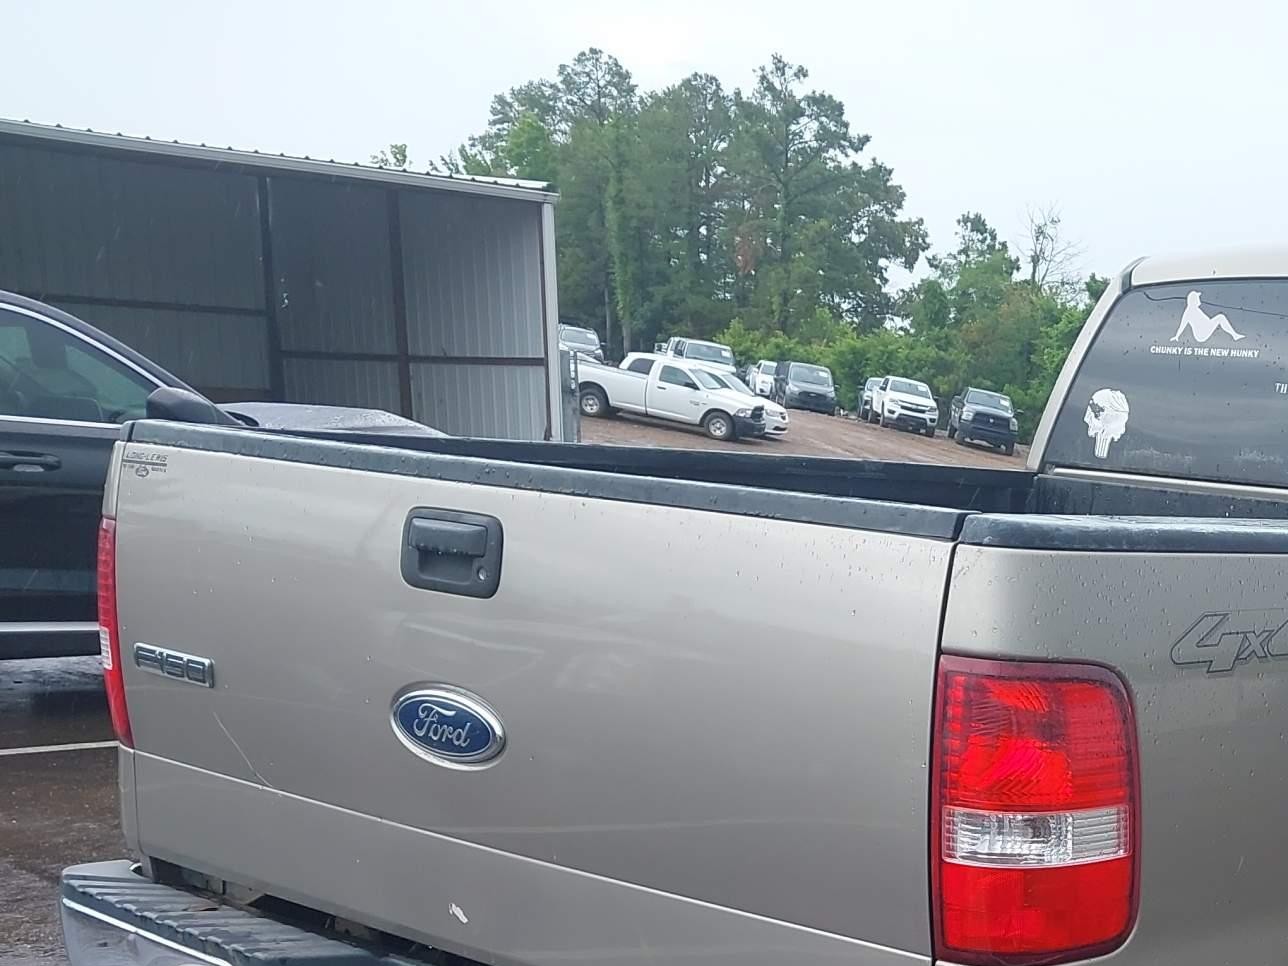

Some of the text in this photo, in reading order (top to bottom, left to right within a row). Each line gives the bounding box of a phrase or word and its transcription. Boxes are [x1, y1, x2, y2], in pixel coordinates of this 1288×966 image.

[1150, 345, 1259, 358] CHUNKY IS THE NEW HUNKY
[413, 702, 471, 747] Ford
